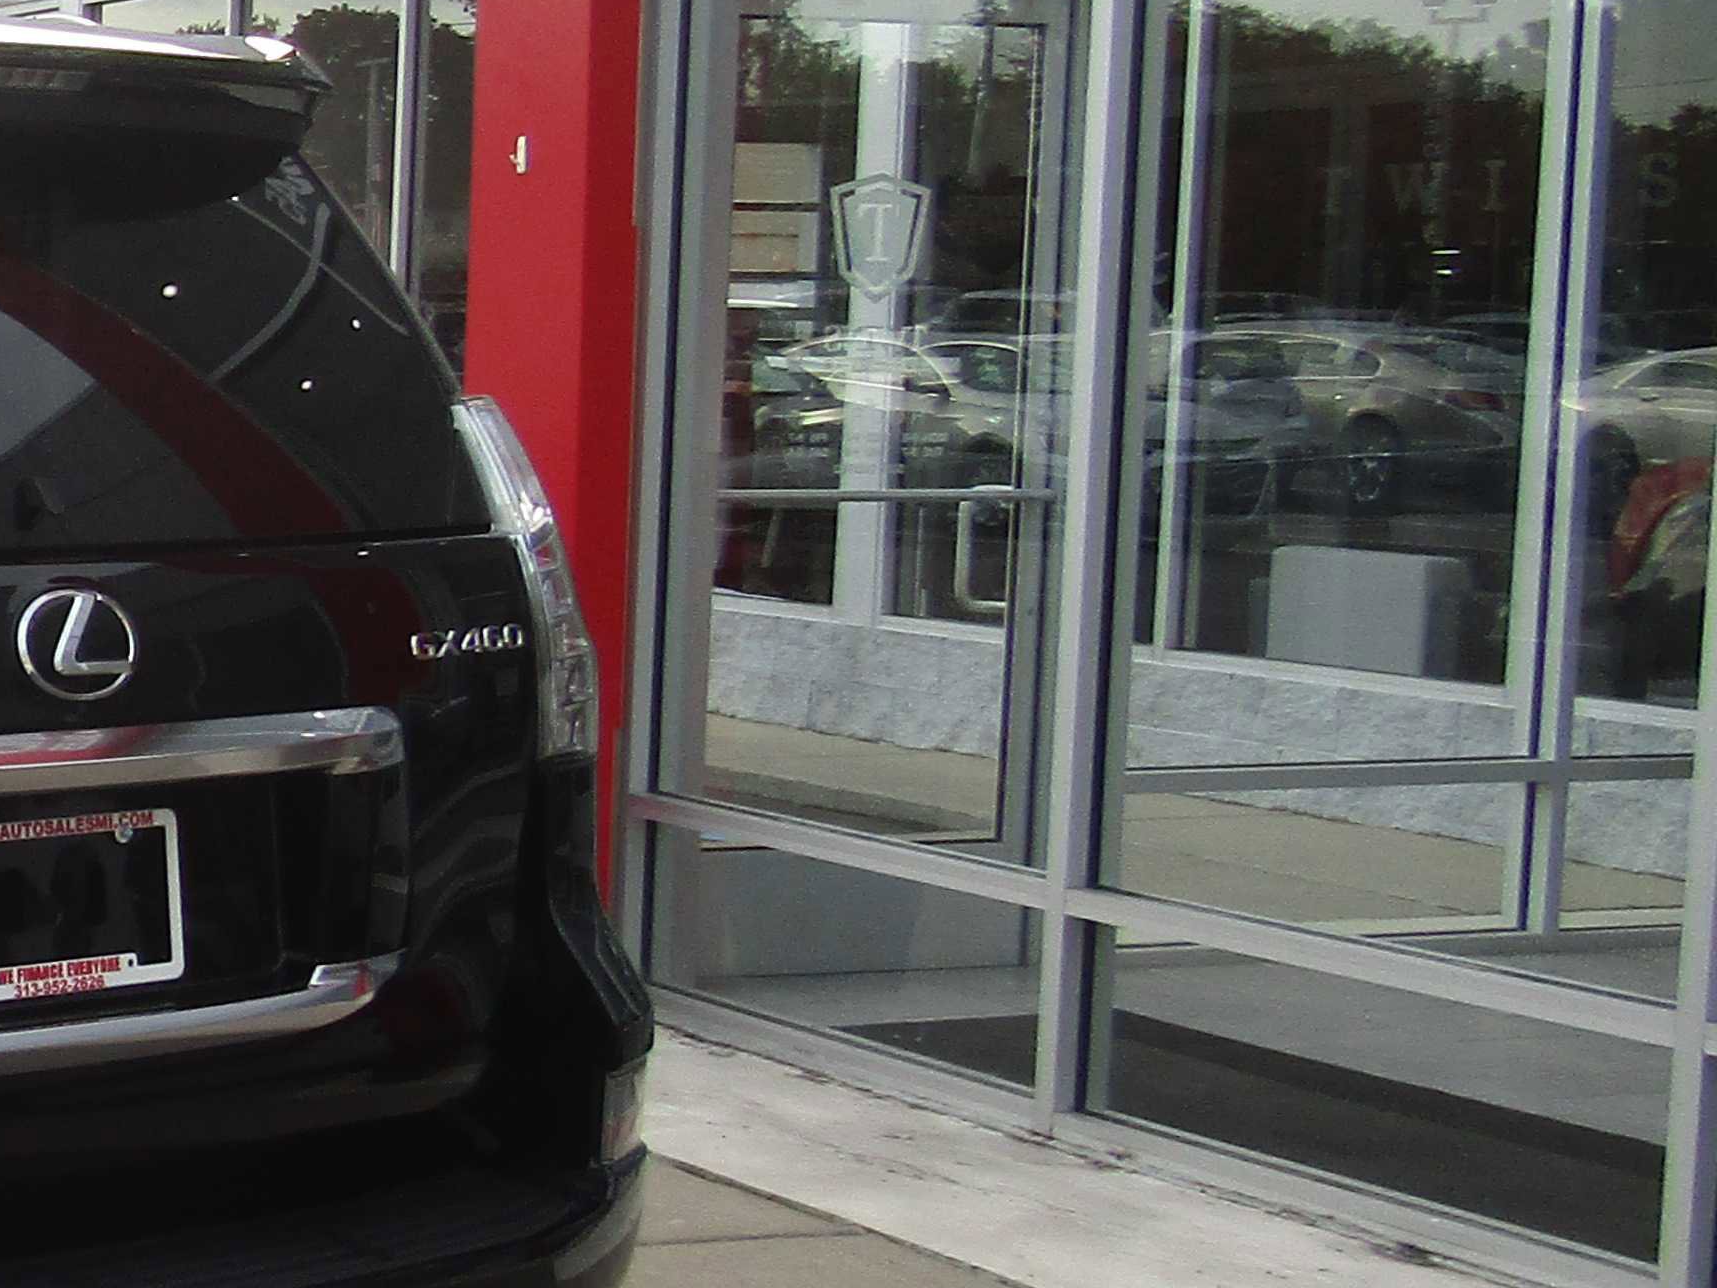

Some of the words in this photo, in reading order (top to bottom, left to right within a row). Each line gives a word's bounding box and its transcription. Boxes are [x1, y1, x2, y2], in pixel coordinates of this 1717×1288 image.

[410, 622, 523, 661] GX460
[17, 962, 64, 984] FINANCE
[67, 956, 121, 977] EVERYONE
